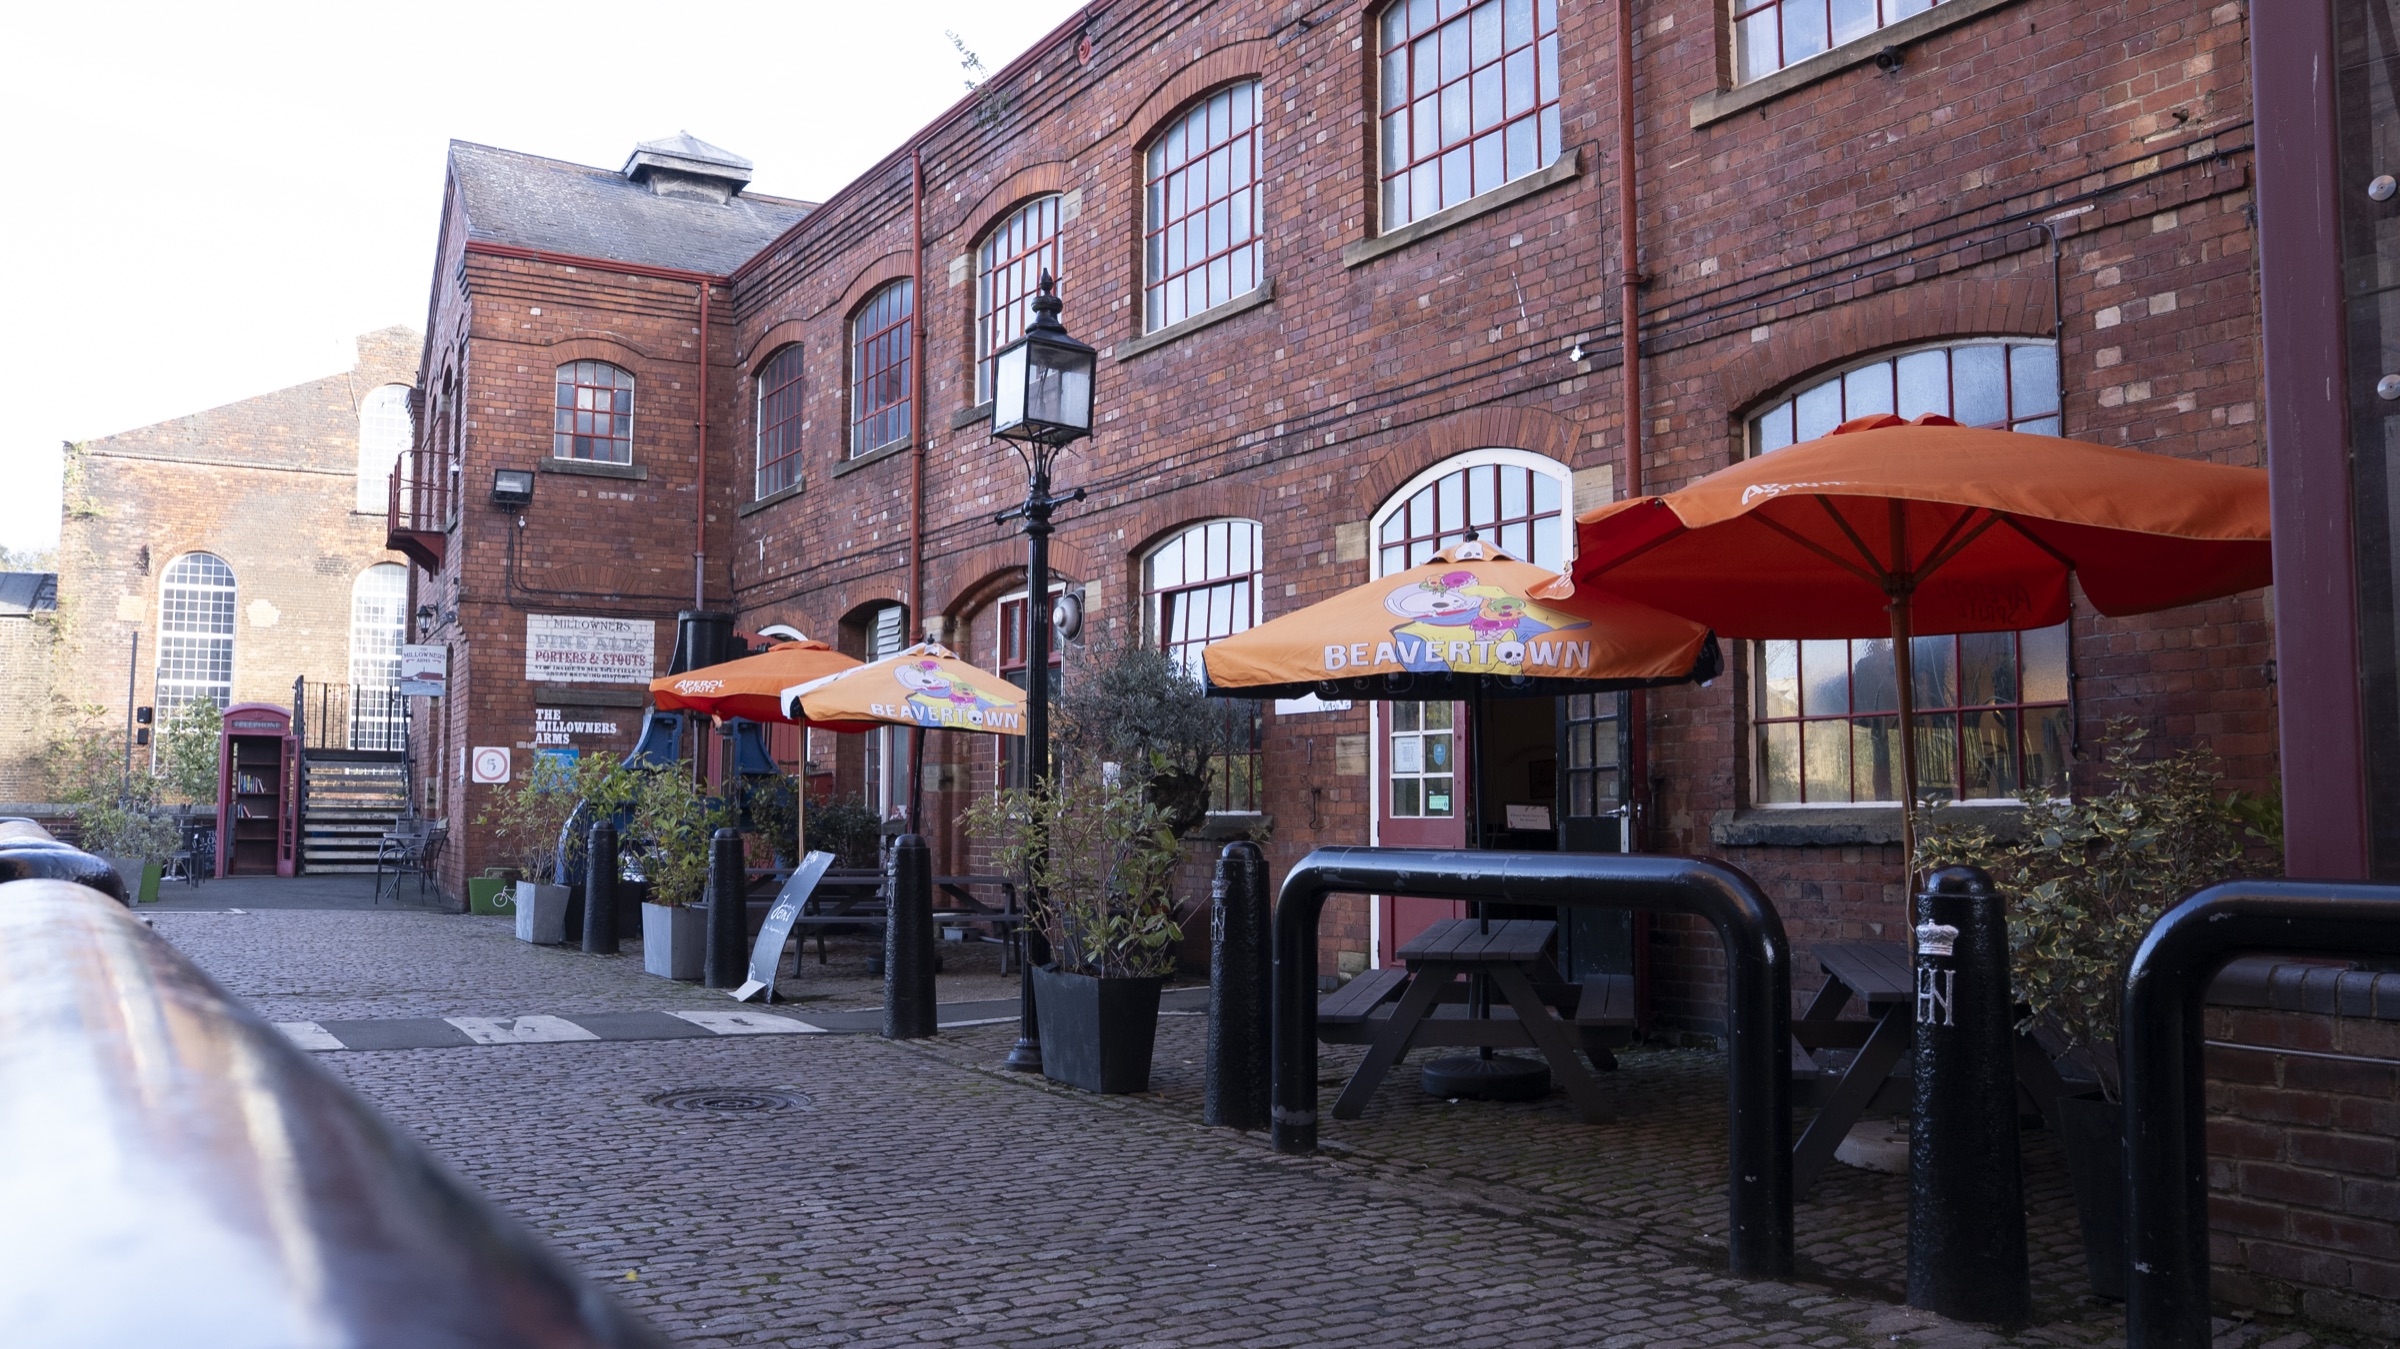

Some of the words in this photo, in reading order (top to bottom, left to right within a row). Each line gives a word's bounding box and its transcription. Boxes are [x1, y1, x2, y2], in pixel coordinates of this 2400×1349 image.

[554, 619, 630, 632] MILLOWNERS
[535, 634, 588, 650] FINE
[594, 637, 648, 653] ALES
[403, 652, 446, 660] MILLOWNERS
[535, 650, 587, 664] PORTERS
[589, 651, 599, 665] &
[602, 653, 646, 667] STOUTS
[1324, 640, 1591, 671] BEAVERTOWN
[674, 679, 725, 689] APEROL
[681, 686, 716, 695] SPRITZ
[535, 708, 561, 721] THE
[870, 703, 1019, 729] BEAVERTOWN
[232, 720, 281, 729] TELEPHONE
[535, 721, 617, 734] MILLOWNERS
[535, 733, 570, 745] ARMS
[486, 758, 496, 772] 5
